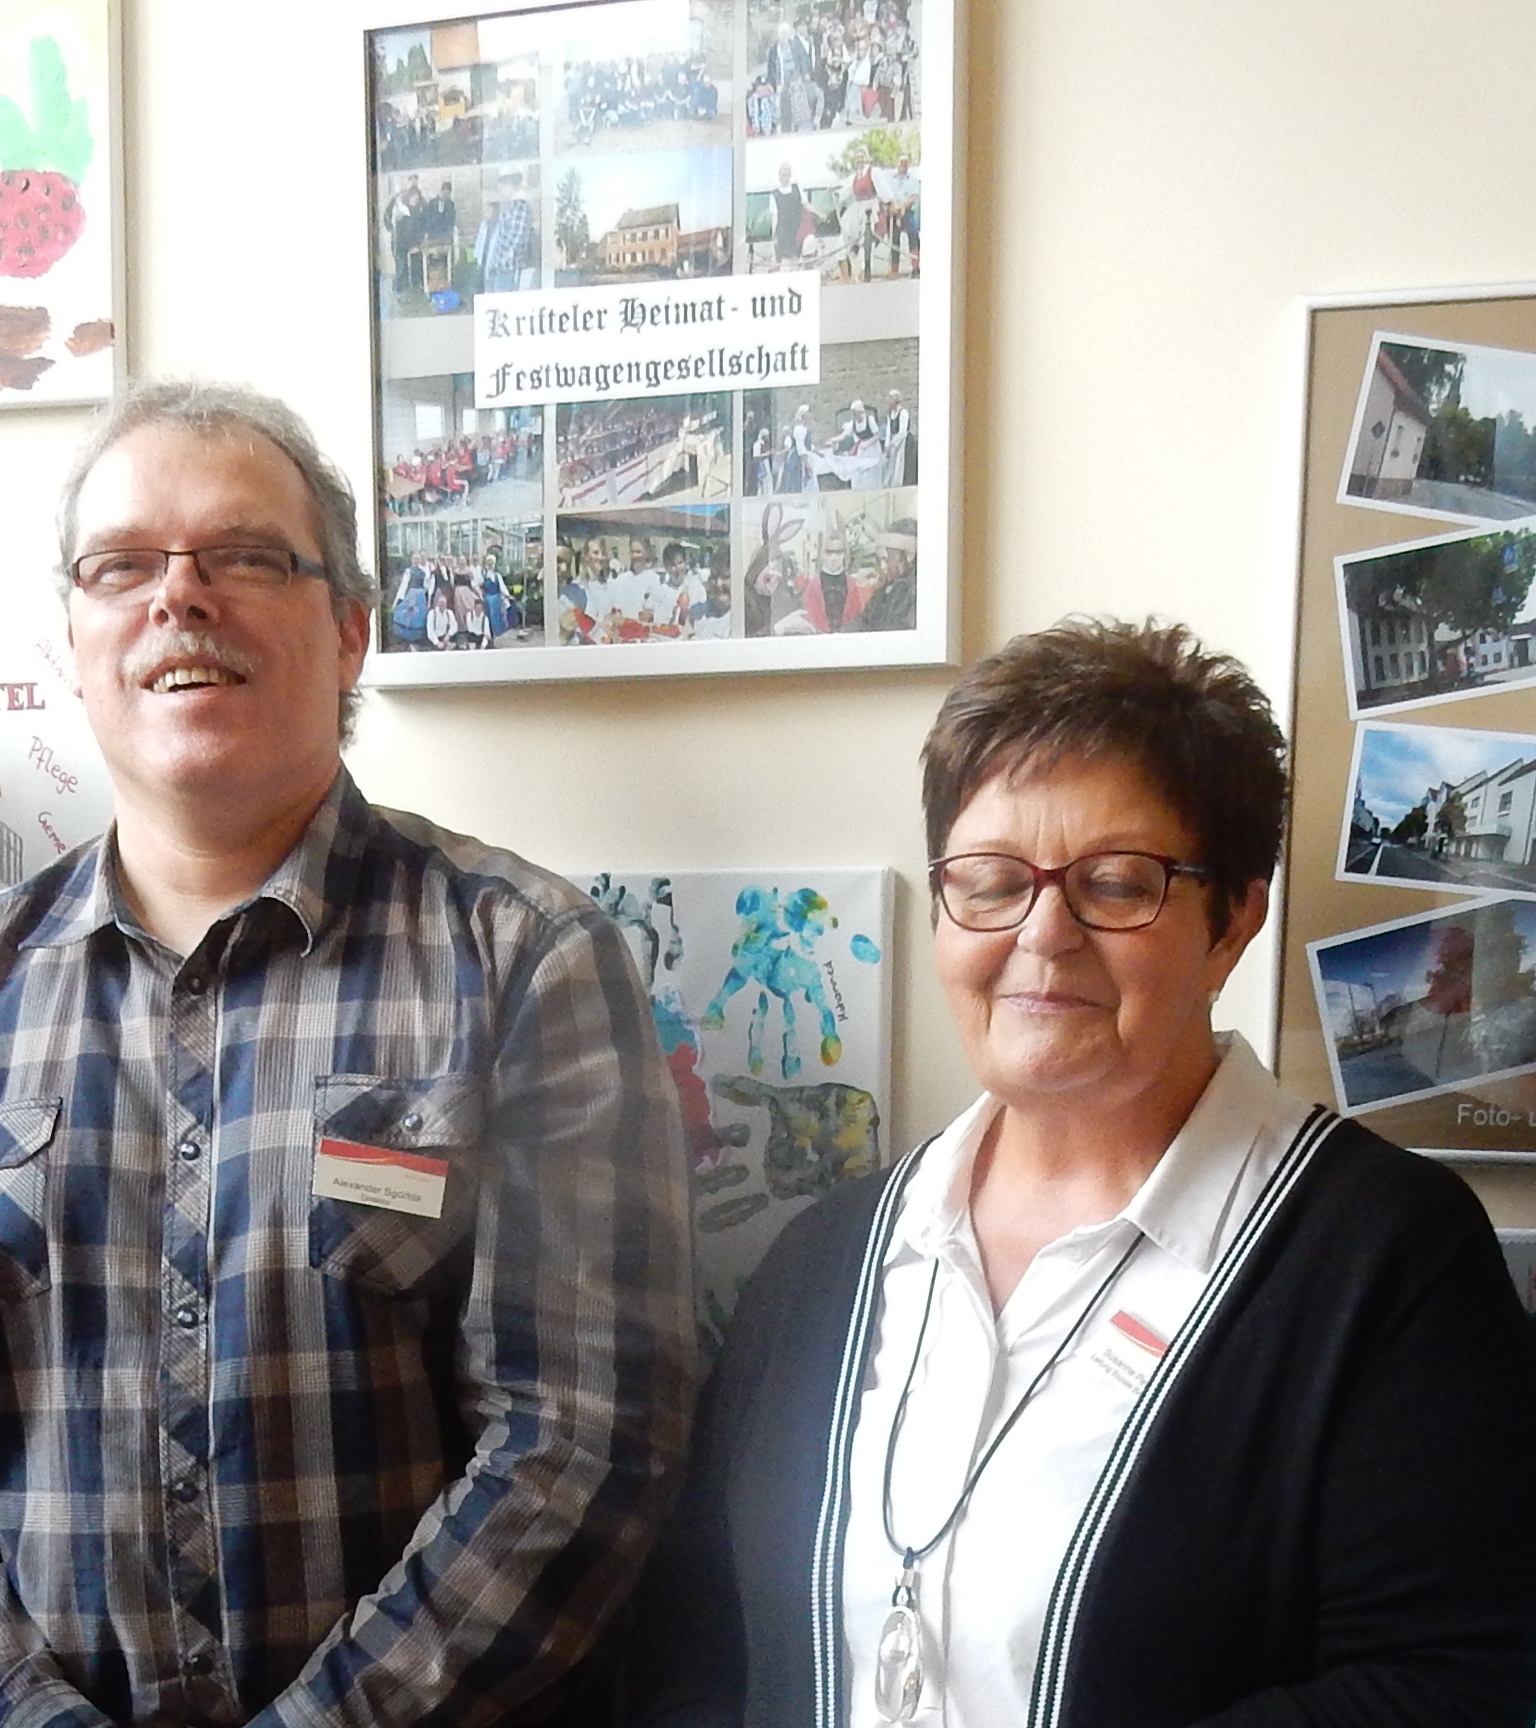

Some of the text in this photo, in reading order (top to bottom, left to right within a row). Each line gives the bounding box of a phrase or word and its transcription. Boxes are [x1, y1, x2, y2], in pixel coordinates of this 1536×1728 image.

[486, 304, 608, 339] Krifteler
[750, 287, 803, 319] und
[485, 342, 810, 399] Festwagengesellschaft
[28, 735, 78, 795] Pflege
[1457, 1103, 1523, 1127] Foto-
